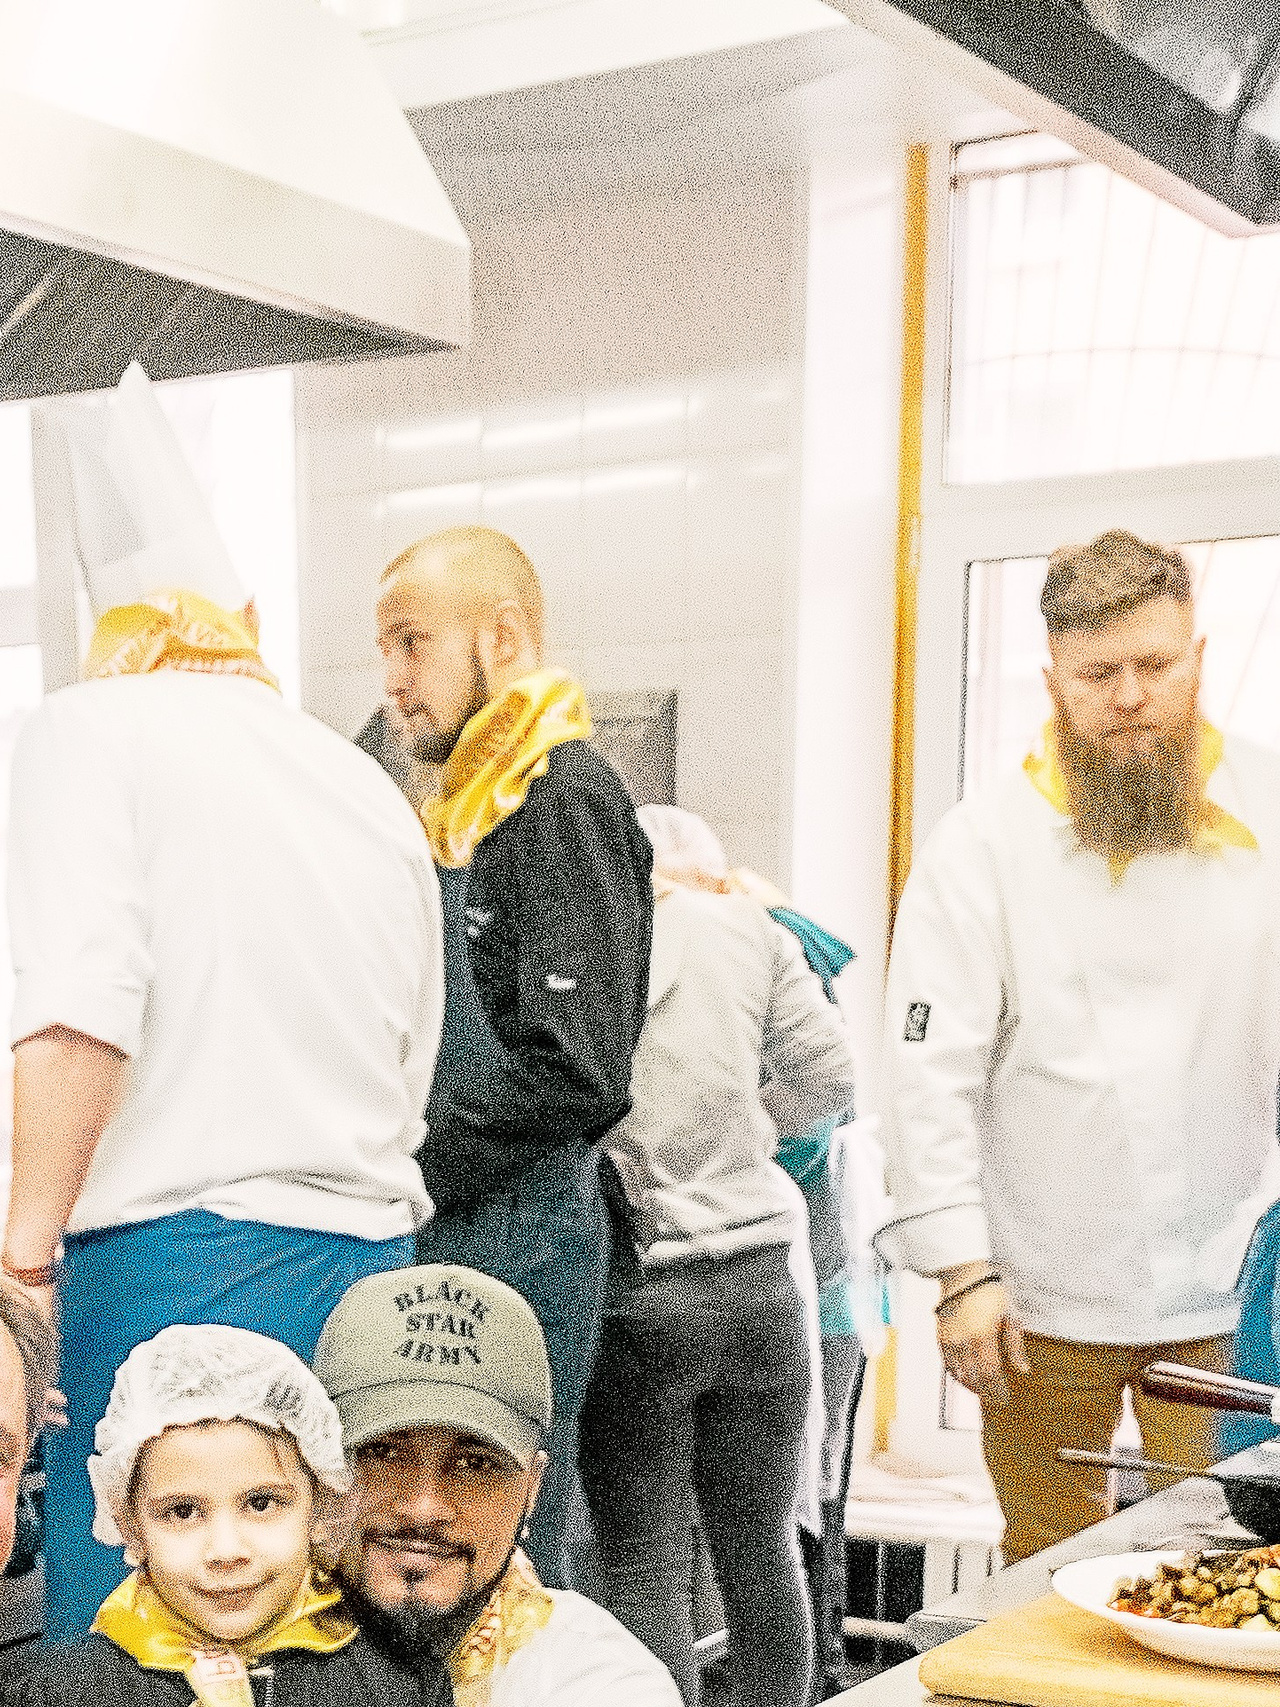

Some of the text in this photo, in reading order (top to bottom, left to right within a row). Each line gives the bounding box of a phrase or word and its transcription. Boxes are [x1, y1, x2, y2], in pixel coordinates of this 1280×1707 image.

[394, 1280, 490, 1322] BLACK
[406, 1312, 476, 1338] STAR
[394, 1338, 482, 1365] ARMY
